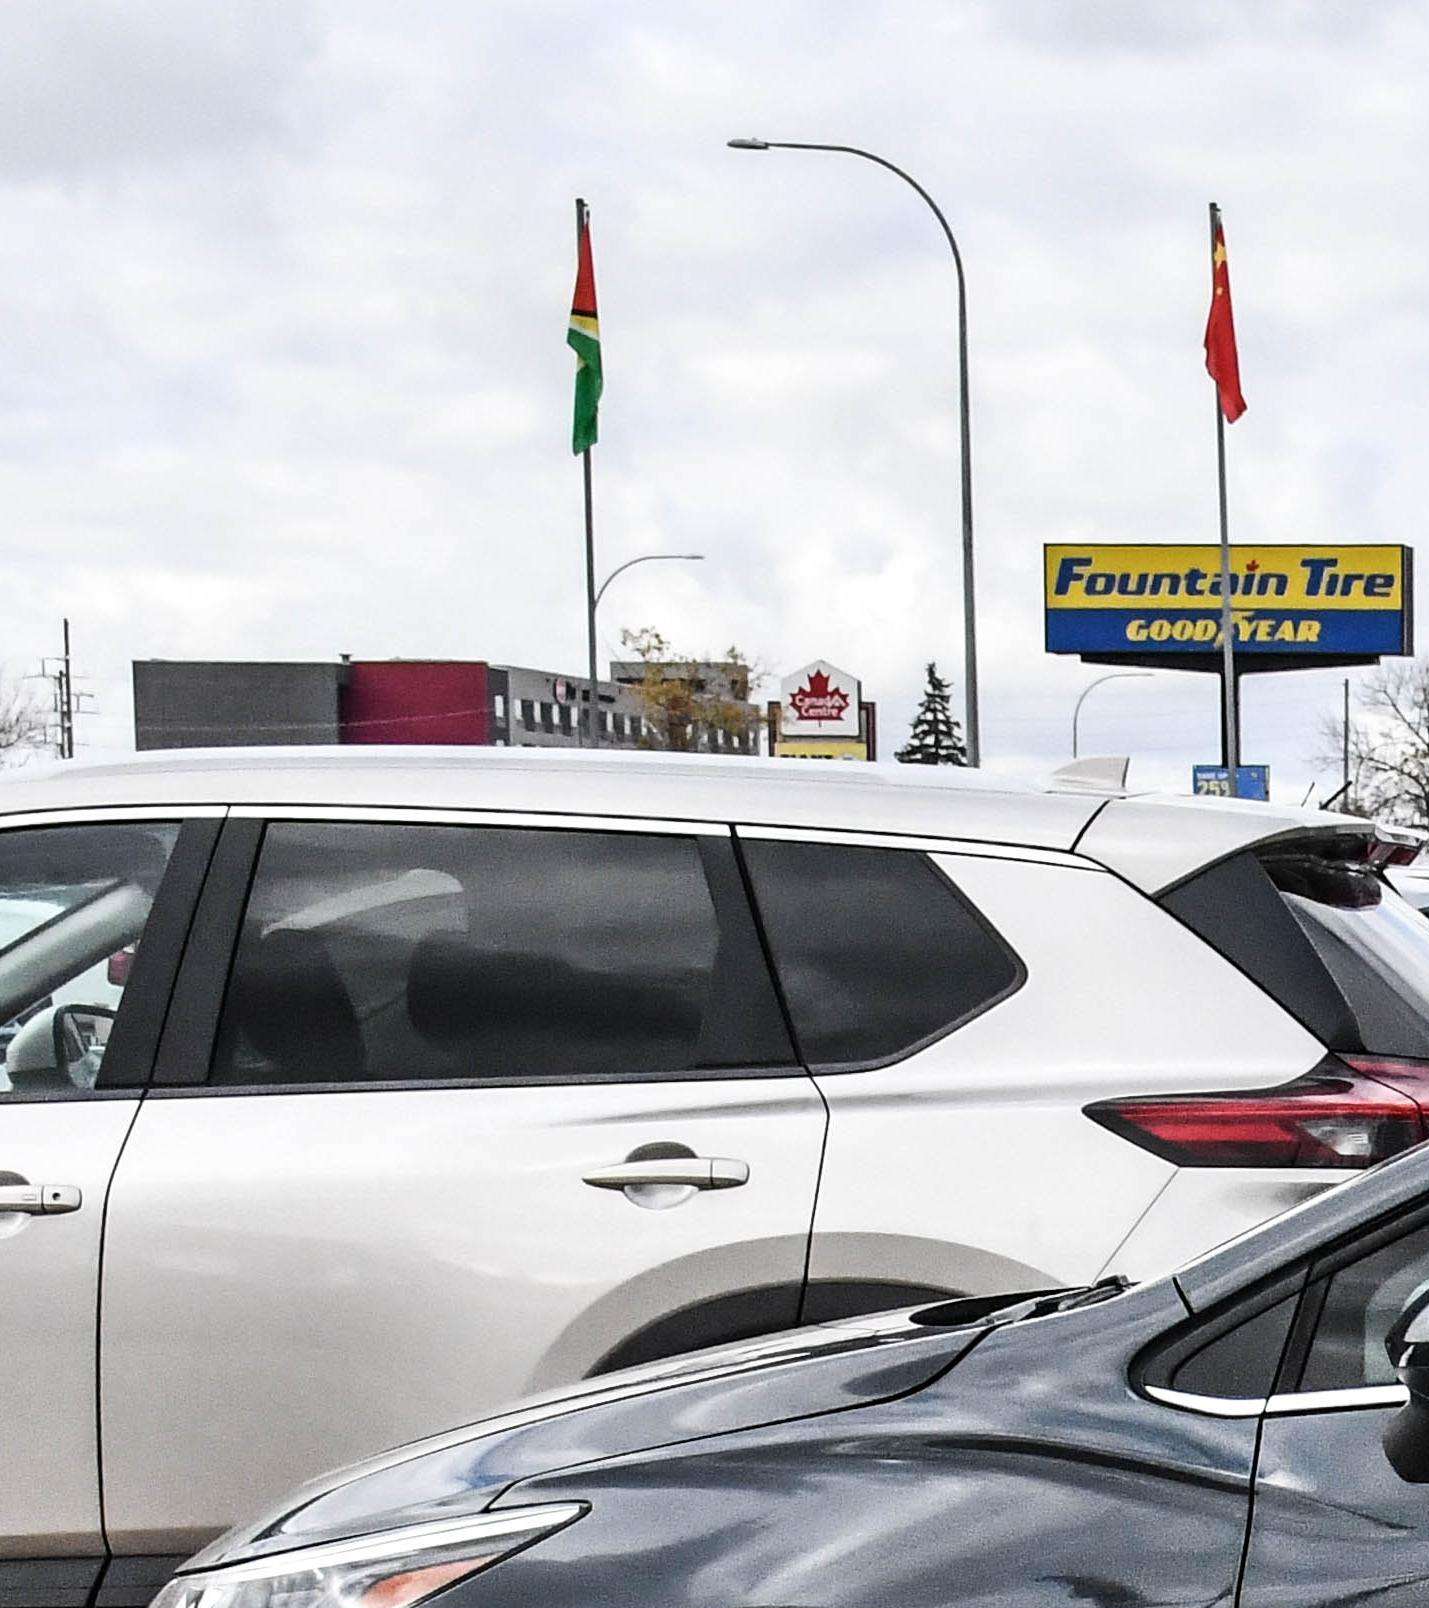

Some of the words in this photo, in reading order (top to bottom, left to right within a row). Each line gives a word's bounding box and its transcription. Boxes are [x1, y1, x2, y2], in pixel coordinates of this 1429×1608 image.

[1054, 557, 1288, 597] Fountain
[1300, 558, 1396, 598] Tire
[1125, 614, 1321, 645] GOODYEAR
